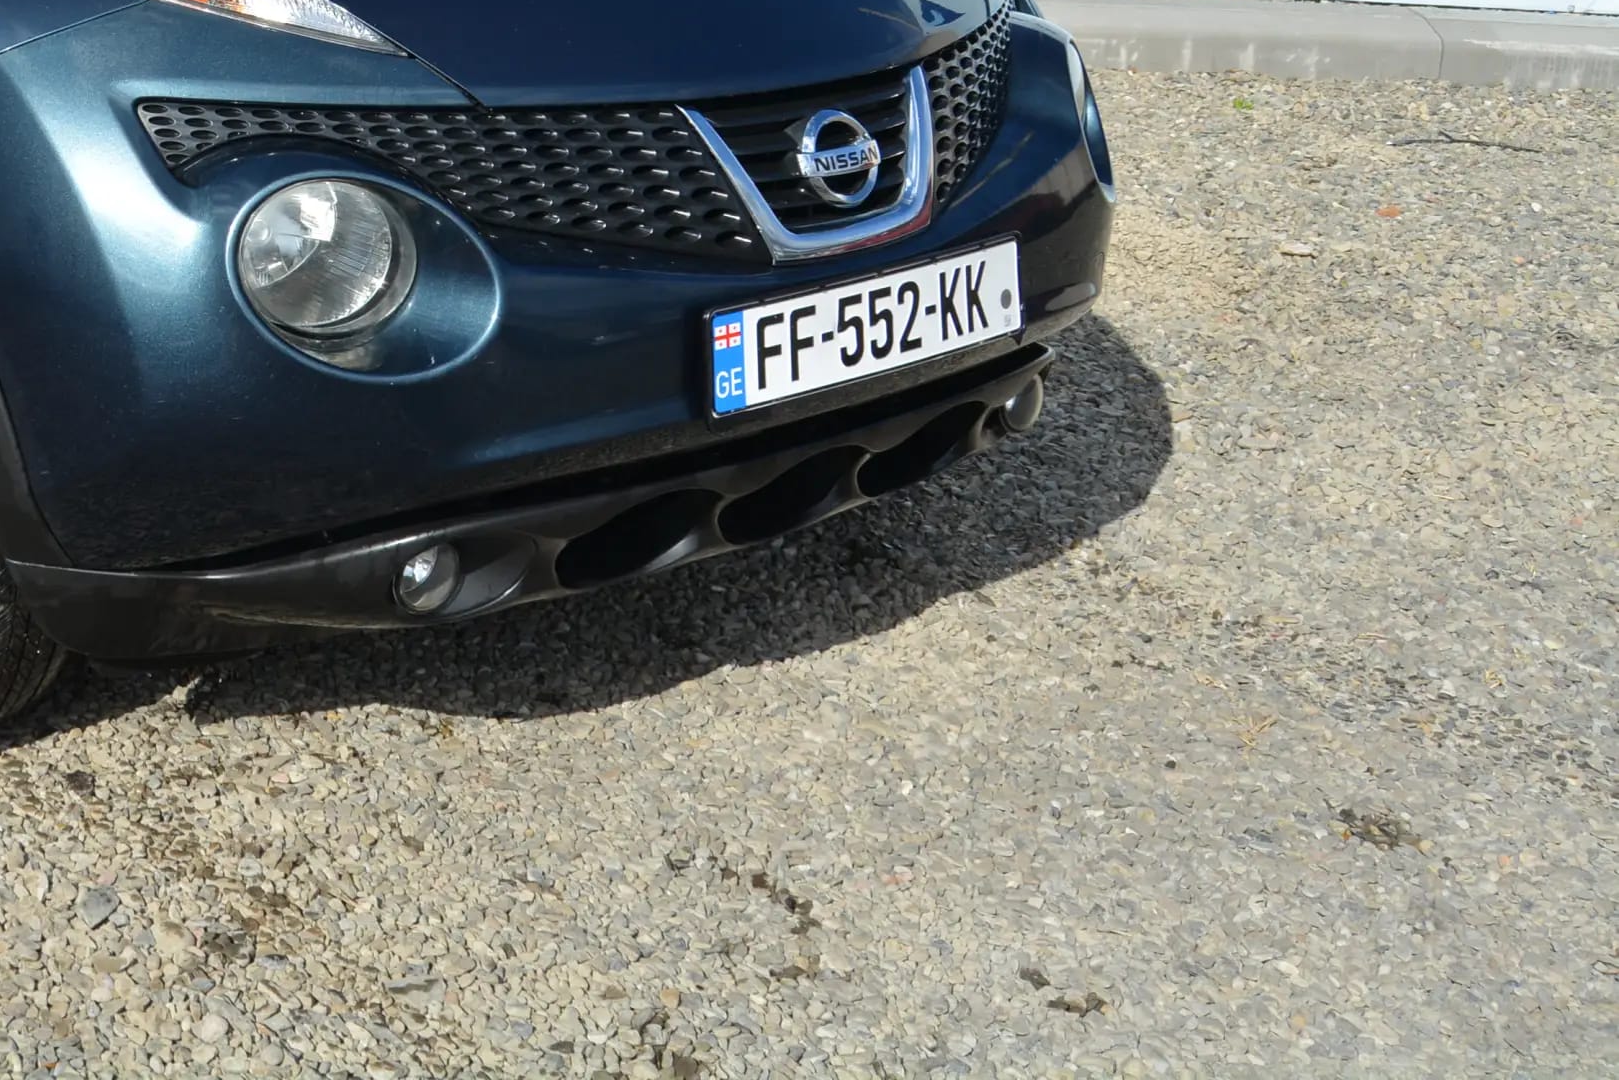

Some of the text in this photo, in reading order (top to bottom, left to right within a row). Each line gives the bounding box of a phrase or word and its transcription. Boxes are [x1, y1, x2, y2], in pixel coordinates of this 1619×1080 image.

[813, 145, 879, 173] NISSAN
[756, 260, 989, 391] FF-552-KK
[715, 367, 743, 399] GE
